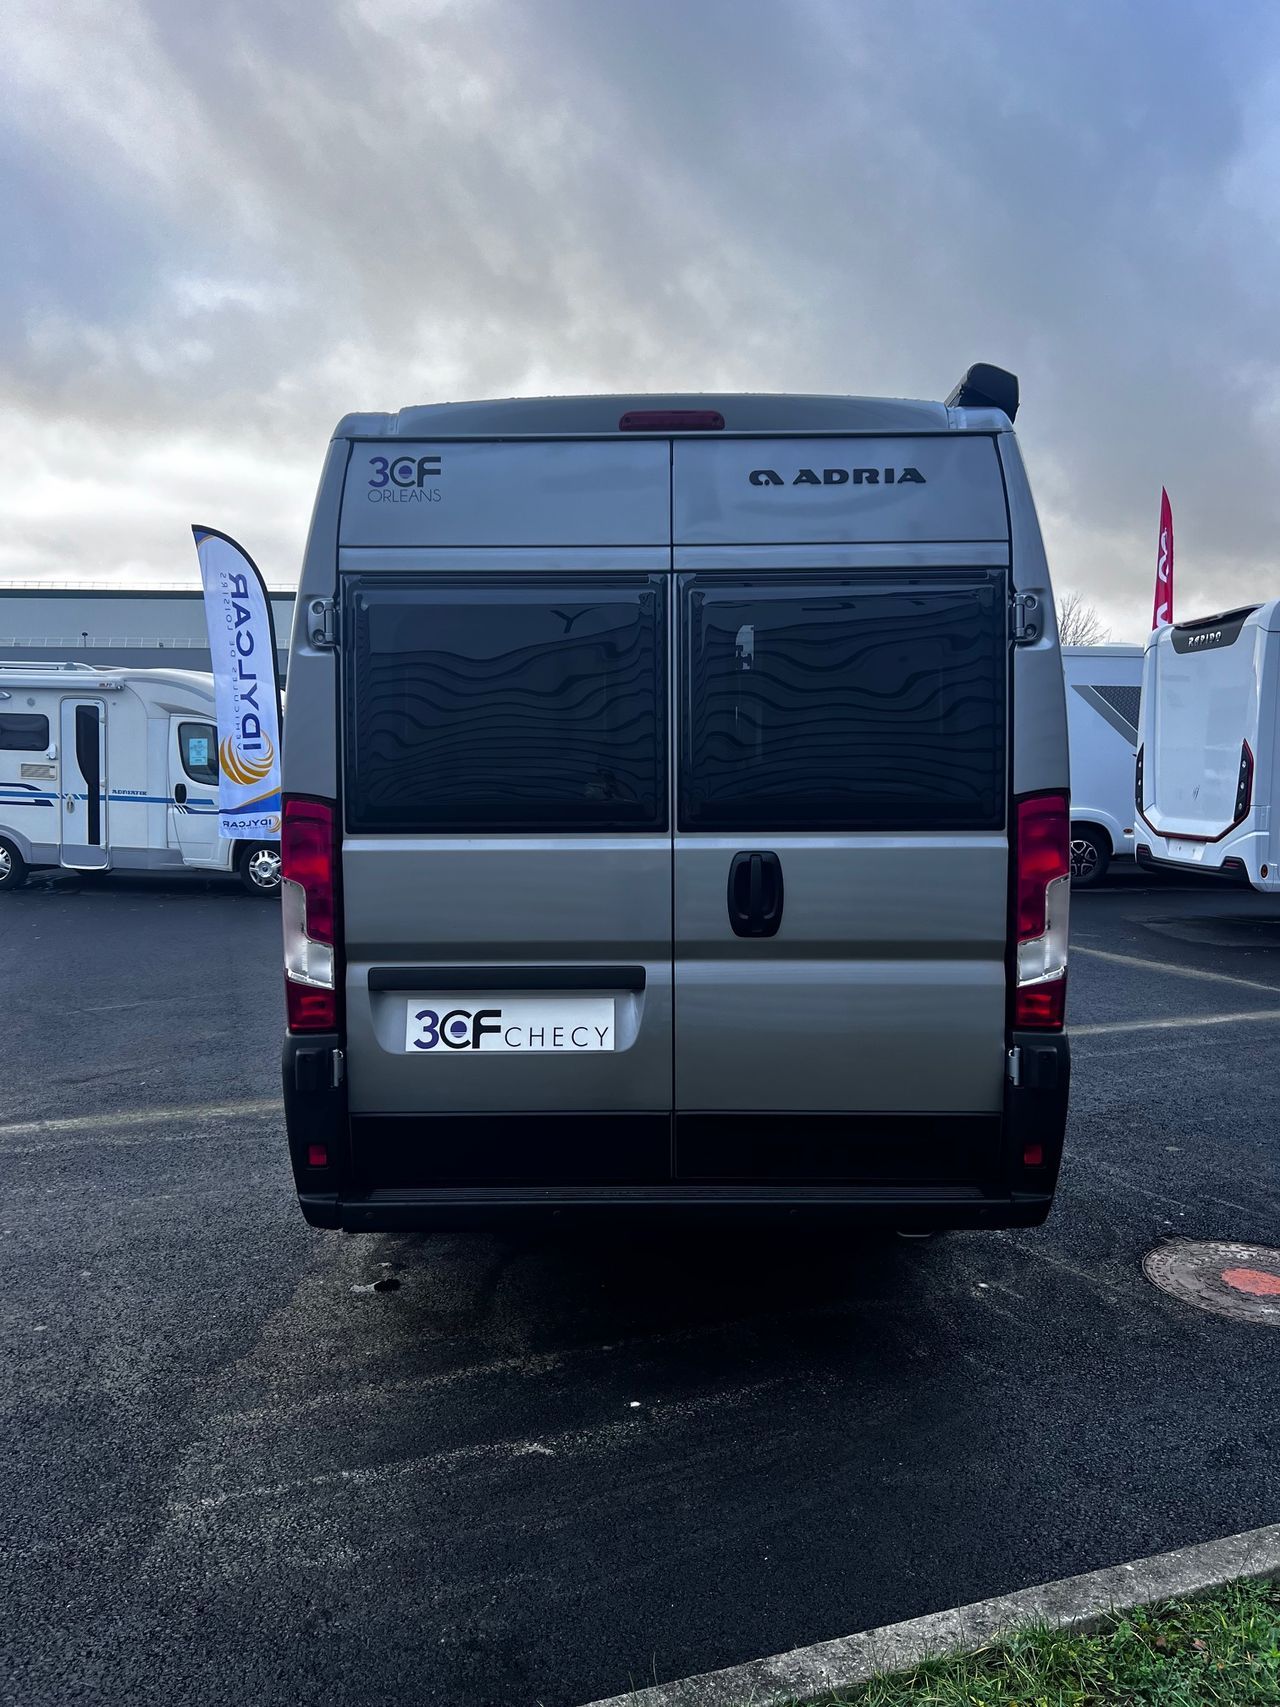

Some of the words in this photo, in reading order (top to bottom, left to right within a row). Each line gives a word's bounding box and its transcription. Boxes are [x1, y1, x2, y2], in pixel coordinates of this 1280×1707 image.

[368, 456, 442, 488] 3CF
[792, 468, 927, 485] ADRIA
[367, 488, 442, 503] ORLEANS
[413, 1009, 502, 1050] 3CF
[504, 1026, 609, 1048] CHECY
